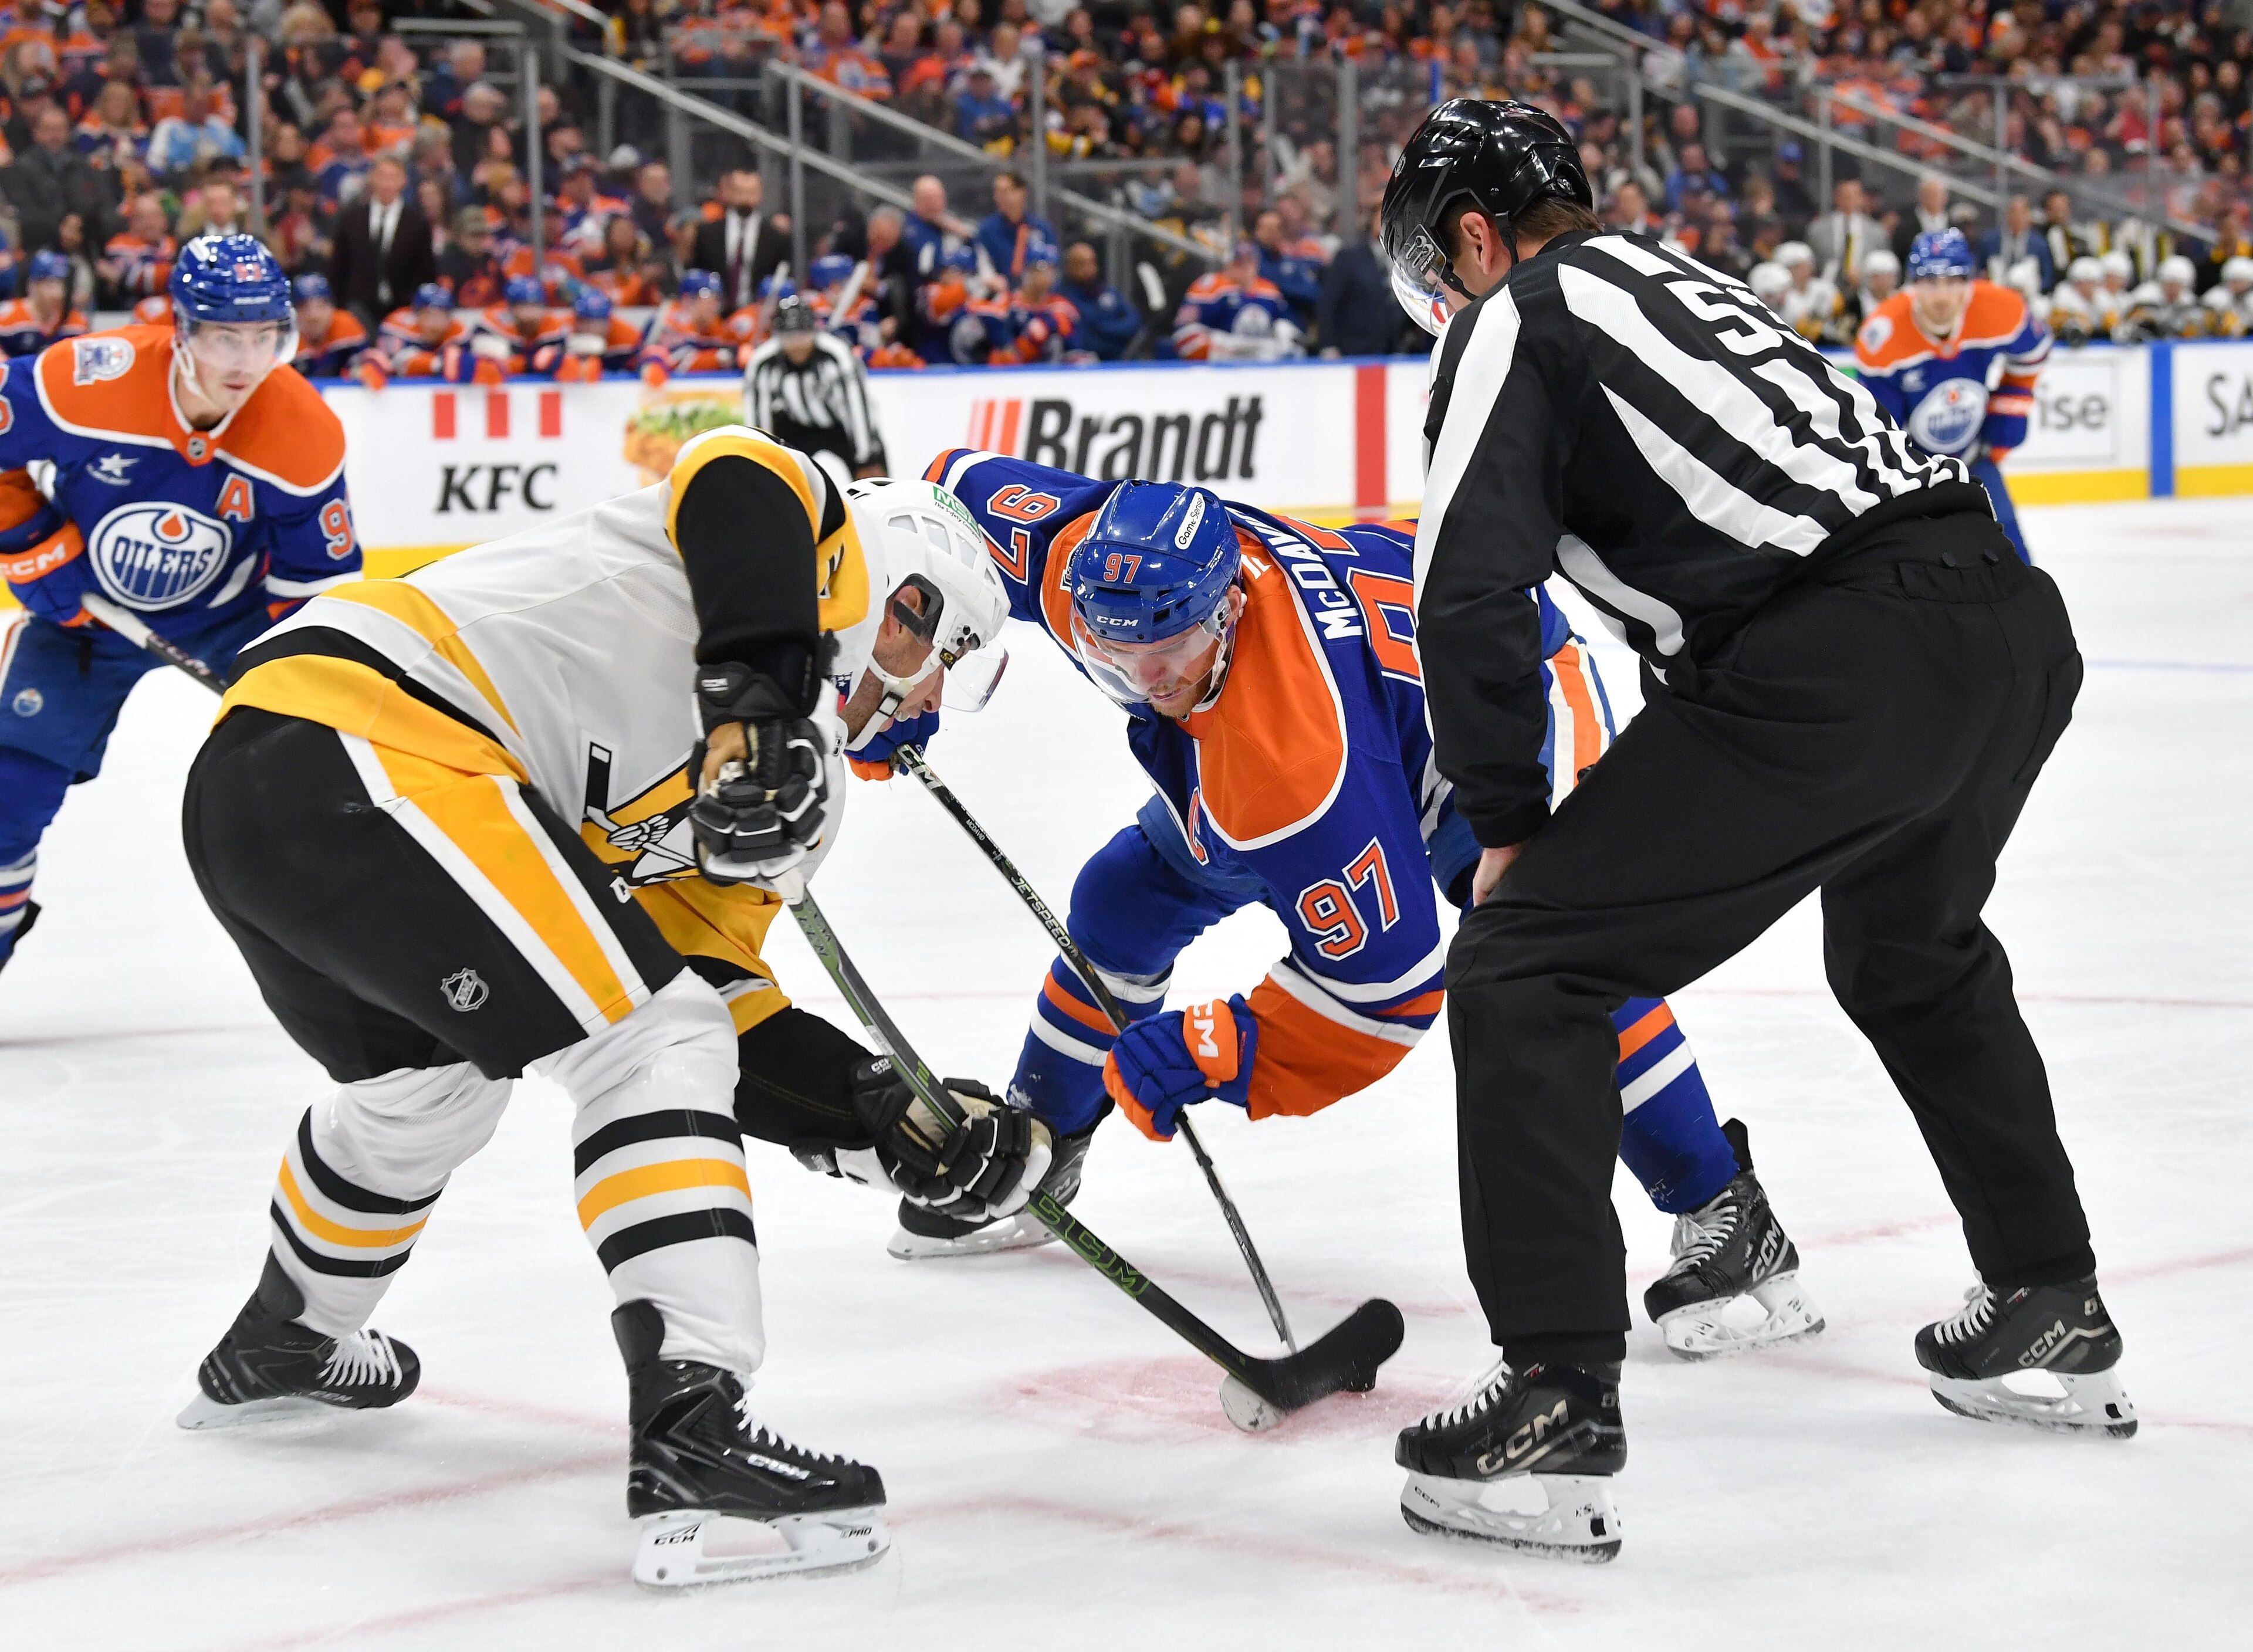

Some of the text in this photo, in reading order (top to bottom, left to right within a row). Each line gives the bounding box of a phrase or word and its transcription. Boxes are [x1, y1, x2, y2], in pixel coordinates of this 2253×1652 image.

[1420, 251, 1436, 273] BAUER
[2038, 381, 2108, 431] ise
[1024, 396, 1263, 483] Brandt
[215, 472, 255, 522] A
[436, 463, 558, 513] KFC
[935, 501, 944, 510] The
[946, 507, 962, 523] Safety
[318, 490, 357, 560] 9
[112, 535, 215, 581] OILERS
[1103, 553, 1142, 584] 97
[1095, 614, 1139, 627] CCM
[1010, 876, 1071, 947] JETSPEED
[1294, 835, 1400, 962] 97
[1751, 1217, 1782, 1283] CCM
[2017, 1318, 2067, 1368] CCM
[1476, 1399, 1571, 1475] CCM
[1414, 1485, 1440, 1508] CCM
[653, 1533, 696, 1546] CCM
